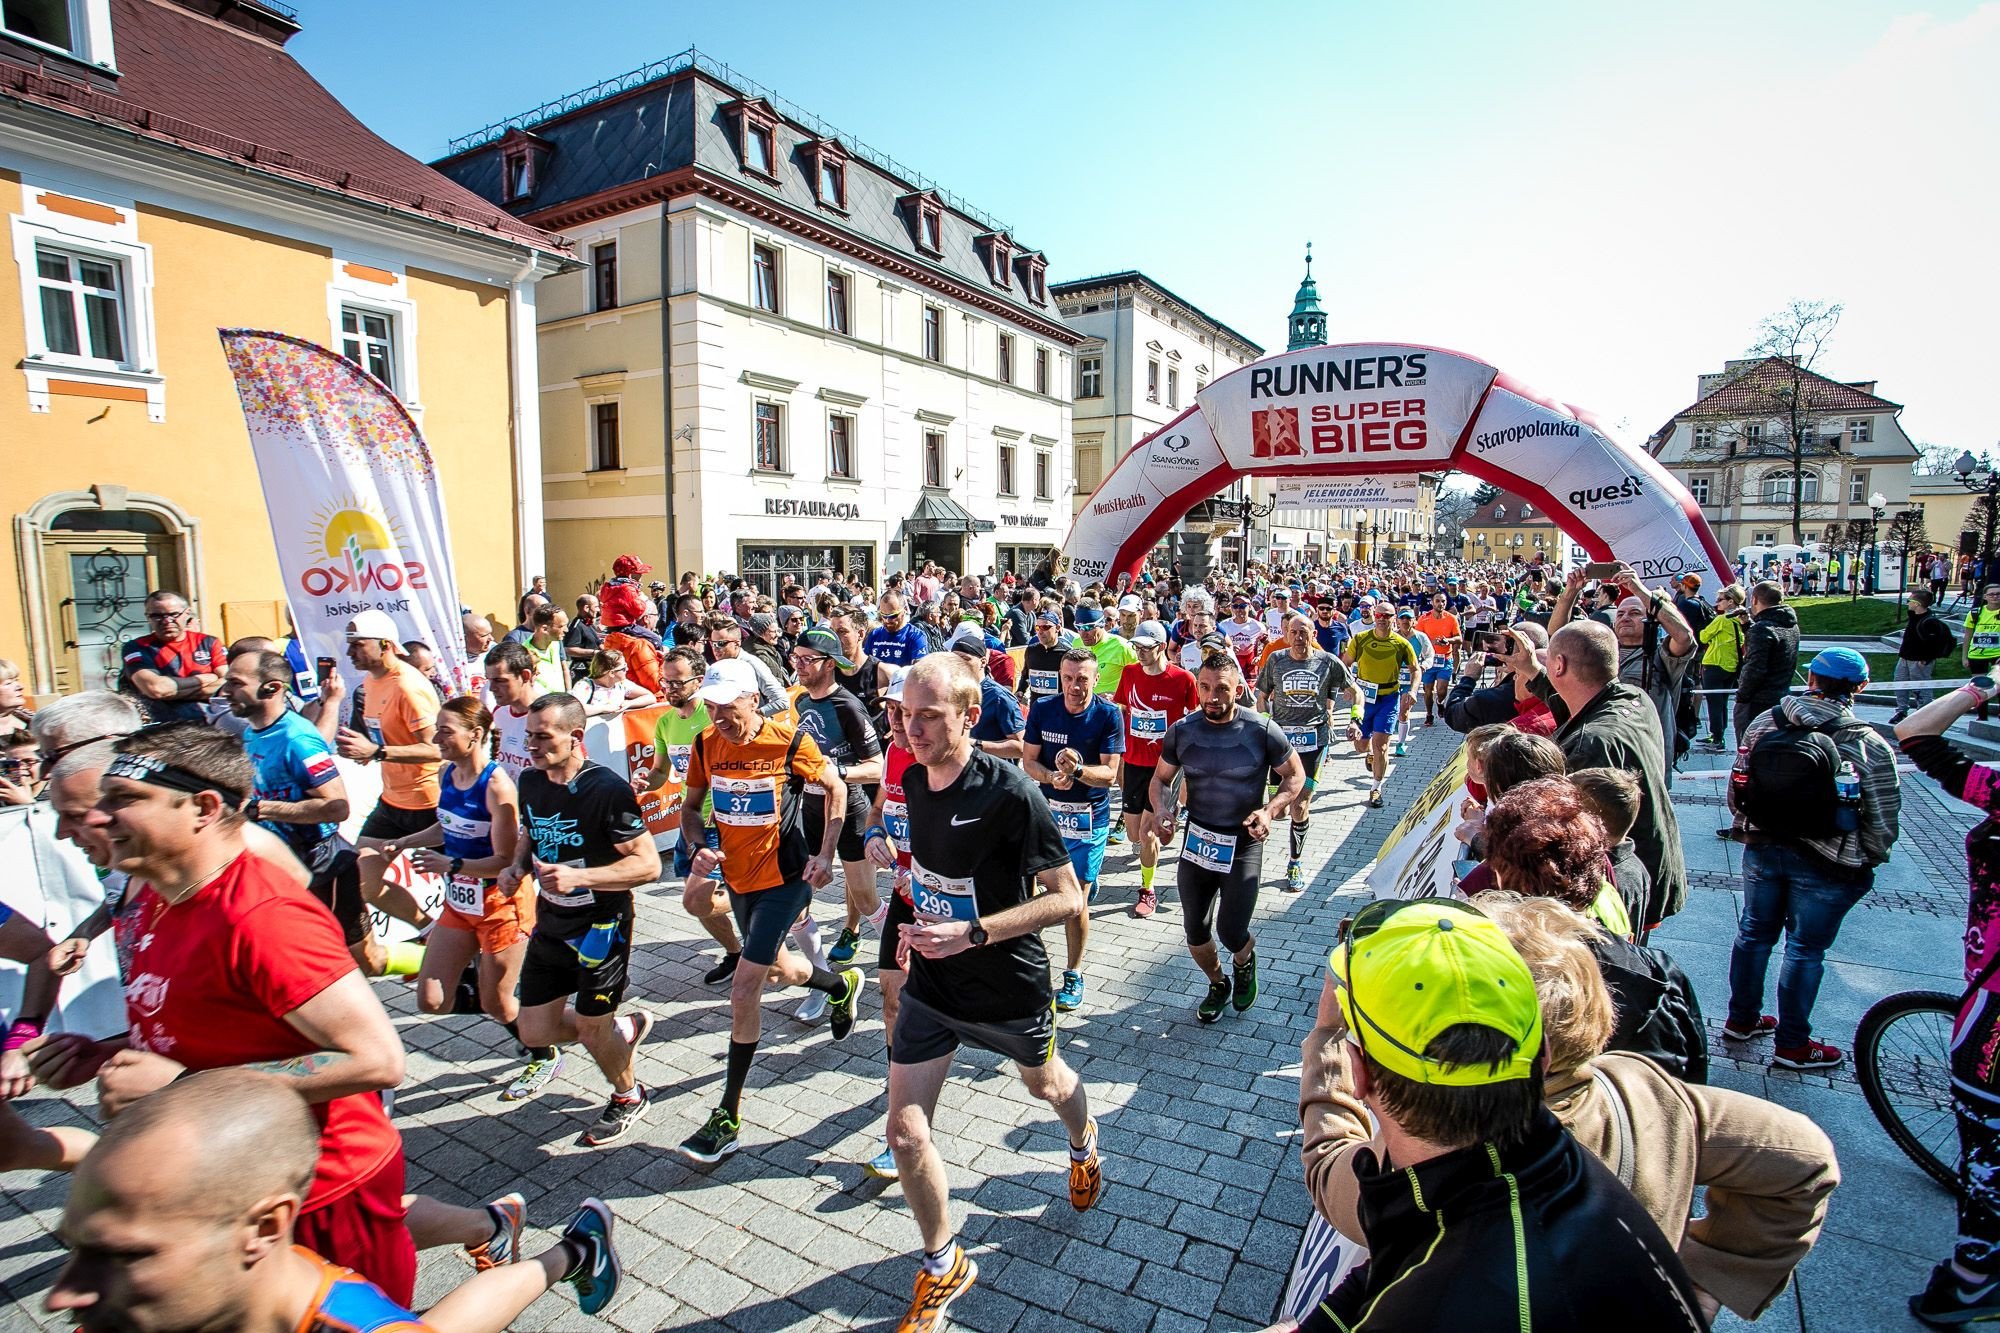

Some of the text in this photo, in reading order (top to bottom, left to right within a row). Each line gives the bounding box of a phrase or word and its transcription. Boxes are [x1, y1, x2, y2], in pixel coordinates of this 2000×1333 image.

[1251, 354, 1427, 399] RUNNER'S
[1405, 379, 1426, 387] WORLD
[1312, 399, 1426, 422] SUPER
[1312, 420, 1427, 454] BIEG
[1476, 420, 1580, 453] Staropolanka
[1304, 488, 1386, 499] JELENIOGÓRSKI
[1569, 475, 1643, 510] quest
[765, 498, 860, 521] RESTAURACJA
[1591, 499, 1634, 510] sportswear
[1073, 558, 1108, 570] DOLNY
[1035, 679, 1050, 688] 316
[1137, 720, 1156, 731] 362
[1290, 735, 1307, 745] 450
[730, 797, 752, 812] 37
[1057, 814, 1079, 828] 346
[528, 828, 584, 847] umbro
[1196, 842, 1220, 860] 102
[447, 881, 476, 905] 1668
[919, 890, 953, 918] 299
